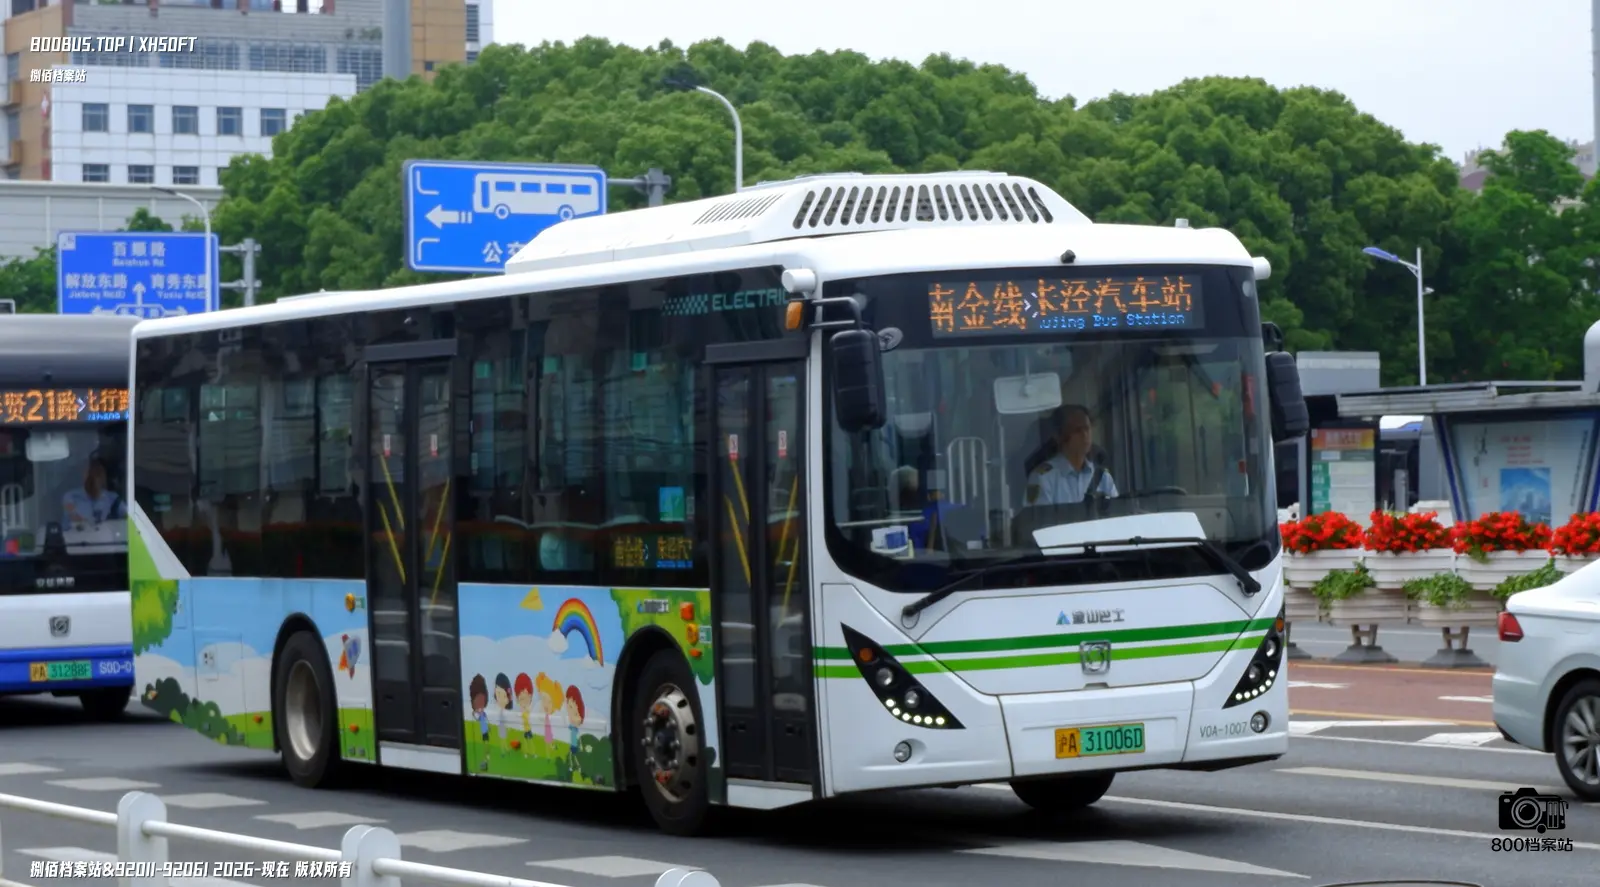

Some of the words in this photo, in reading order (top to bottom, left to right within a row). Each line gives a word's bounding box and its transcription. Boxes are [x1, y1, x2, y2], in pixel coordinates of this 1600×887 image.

[65, 272, 128, 289] 解放东路
[928, 281, 1027, 333] 南金线
[1126, 311, 1186, 326] Station
[0, 389, 79, 422] 贤21路
[1084, 727, 1144, 752] 31006D
